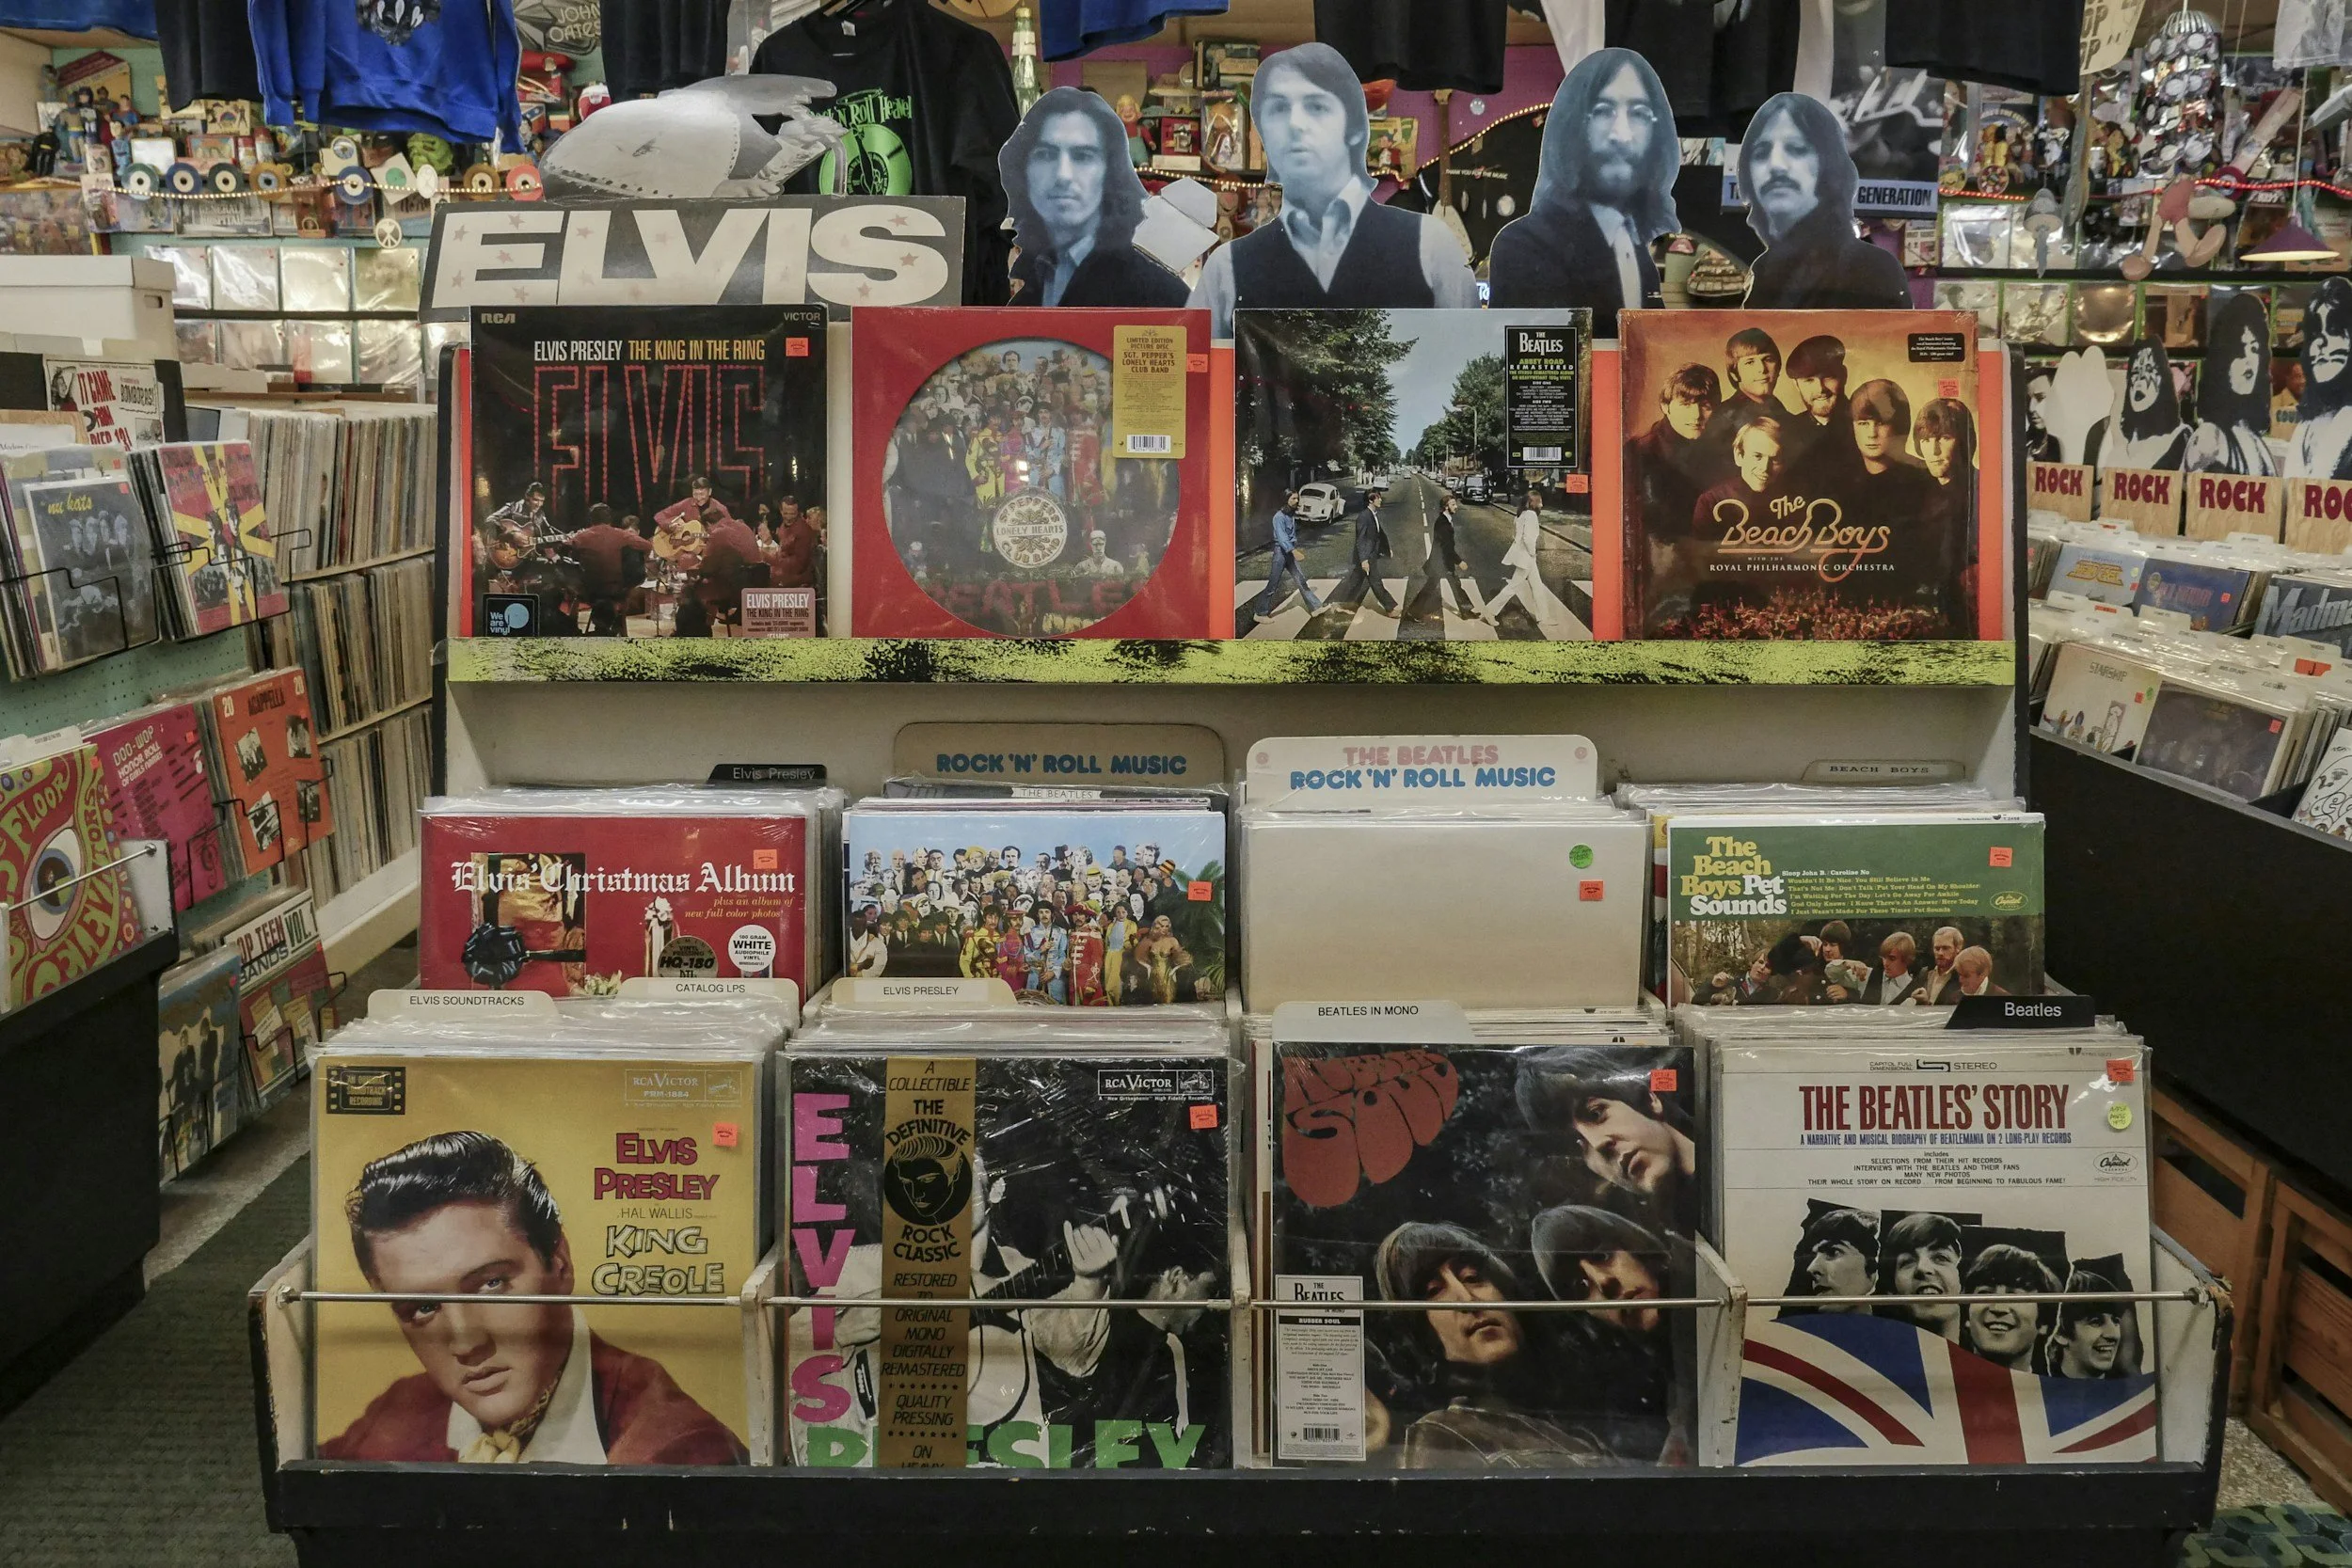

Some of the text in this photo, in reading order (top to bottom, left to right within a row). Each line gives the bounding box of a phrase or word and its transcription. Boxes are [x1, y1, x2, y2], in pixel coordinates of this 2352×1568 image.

[1858, 185, 1931, 206] GENERATION
[432, 205, 948, 307] ELVIS
[481, 313, 516, 325] RCA
[783, 311, 821, 322] VICTOR
[534, 339, 765, 362] ELVIS PRESLEY THE KING IN THE RING
[1518, 332, 1564, 356] BEATLES
[77, 369, 117, 405] IT CAME
[2035, 466, 2083, 497] ROCK
[2114, 472, 2170, 505] ROCK
[2200, 478, 2266, 515] ROCK
[1771, 496, 1805, 519] The
[1712, 498, 1890, 582] Beach Boys
[1709, 563, 1896, 572] ROYAL PHILHARMONIC ORCHESTRA
[746, 593, 810, 609] ELVIS PRESLEY
[489, 611, 503, 620] We
[489, 620, 504, 628] are
[489, 614, 511, 636] vinyl
[112, 725, 154, 768] DOO-WOP
[936, 752, 1187, 775] ROCK 'N' ROLL MUSIC
[1343, 745, 1499, 767] THE BEATLES
[732, 766, 816, 782] Elvis Presley
[1829, 765, 1931, 774] BEACH BOYS
[1290, 766, 1556, 791] ROCK 'N' ROLL MUSIC
[1021, 788, 1095, 800] THE BEATLES
[1706, 835, 1757, 858] The
[1692, 854, 1772, 876] Beach
[451, 861, 796, 895] Elvis' Christmas Album
[1680, 874, 1785, 900] Boys Pet
[713, 895, 796, 908] plus an album of
[1690, 894, 1788, 916] Sounds
[705, 909, 724, 920] full
[725, 909, 749, 918] color
[255, 908, 311, 955] TEEN VOL.
[733, 940, 772, 950] WHITE
[659, 957, 715, 969] HQ-180
[675, 983, 746, 993] CATALOG LPS
[882, 986, 960, 996] ELVIS PRESLEY
[409, 995, 525, 1006] ELVIS SOUNDTRACKS
[1318, 1006, 1420, 1017] BEATLES IN MONO
[2004, 1001, 2062, 1018] Beatles
[924, 1061, 935, 1074] A
[1953, 1061, 1997, 1069] STEREO
[632, 1072, 699, 1088] RCA VICTOR
[888, 1076, 971, 1092] COLLECTIBLE
[1104, 1074, 1173, 1091] RCA VICTOR
[913, 1099, 945, 1116] THE
[1799, 1084, 2070, 1131] THE BEATLES' STORY
[885, 1117, 973, 1148] DEFINITIVE
[1801, 1132, 2073, 1146] A NARRATIVE AND MUSICAL BIOGRAPHY OF BEATLEMANIA ON 2 LONG-PLAY RECORDS
[616, 1132, 697, 1165] ELVIS
[594, 1167, 721, 1200] PRESLEY
[620, 1207, 693, 1219] HAL WALLIS
[605, 1224, 708, 1259] KING
[901, 1224, 956, 1243] ROCK
[893, 1241, 961, 1263] CLASSIC
[592, 1261, 724, 1296] CREOLE
[893, 1273, 958, 1288] RESTORED
[895, 1307, 954, 1323] ORIGINAL
[904, 1326, 946, 1340] MONO
[892, 1344, 955, 1359] DIGITALLY
[881, 1361, 966, 1377] REMASTERED
[896, 1394, 953, 1410] QUALITY
[892, 1411, 954, 1426] PRESSING
[912, 1445, 933, 1459] ON
